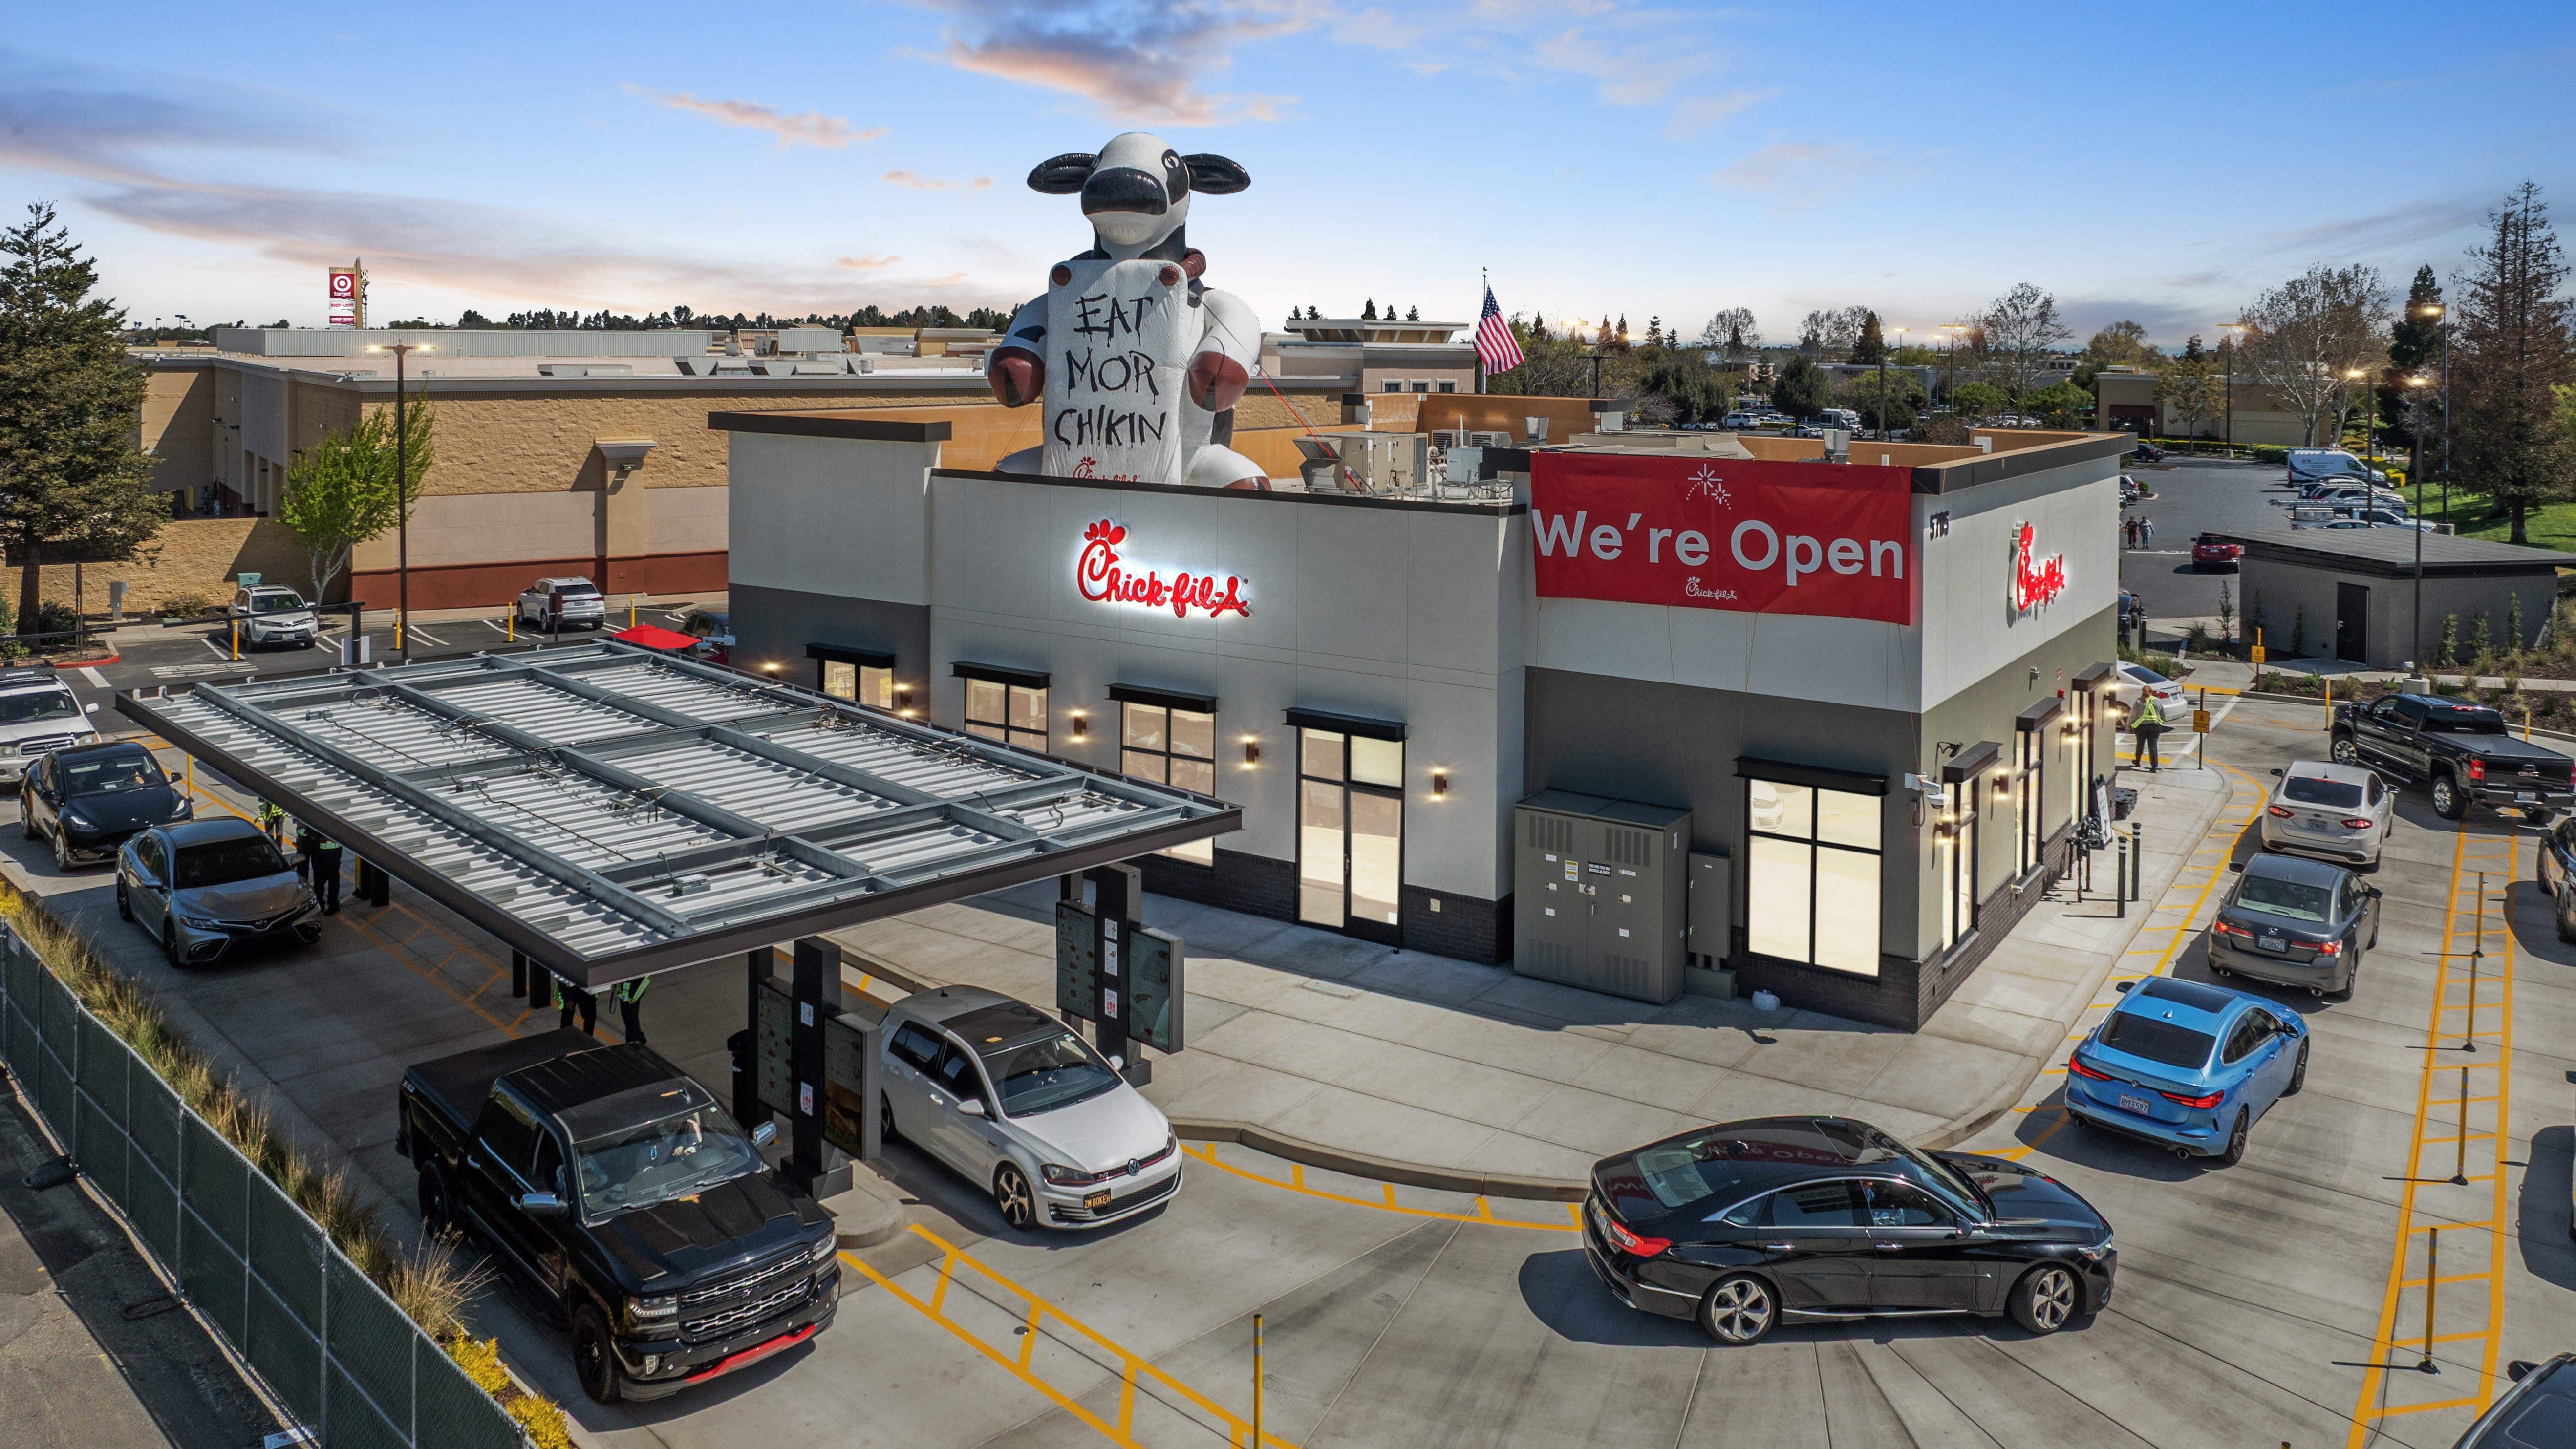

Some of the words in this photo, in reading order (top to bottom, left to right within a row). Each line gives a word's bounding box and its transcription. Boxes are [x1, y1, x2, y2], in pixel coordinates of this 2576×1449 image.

[1073, 293, 1154, 347] EAT
[1065, 346, 1159, 405] MOR
[1054, 405, 1167, 451] CHIKIN
[1532, 508, 1710, 566] We're
[1730, 520, 1903, 586] Open
[1077, 537, 1250, 618] Chick-fil-A
[1686, 580, 1738, 600] Chick-fil-A
[2120, 1097, 2147, 1112] 8YEE597
[1093, 1194, 1111, 1207] BOKEH
